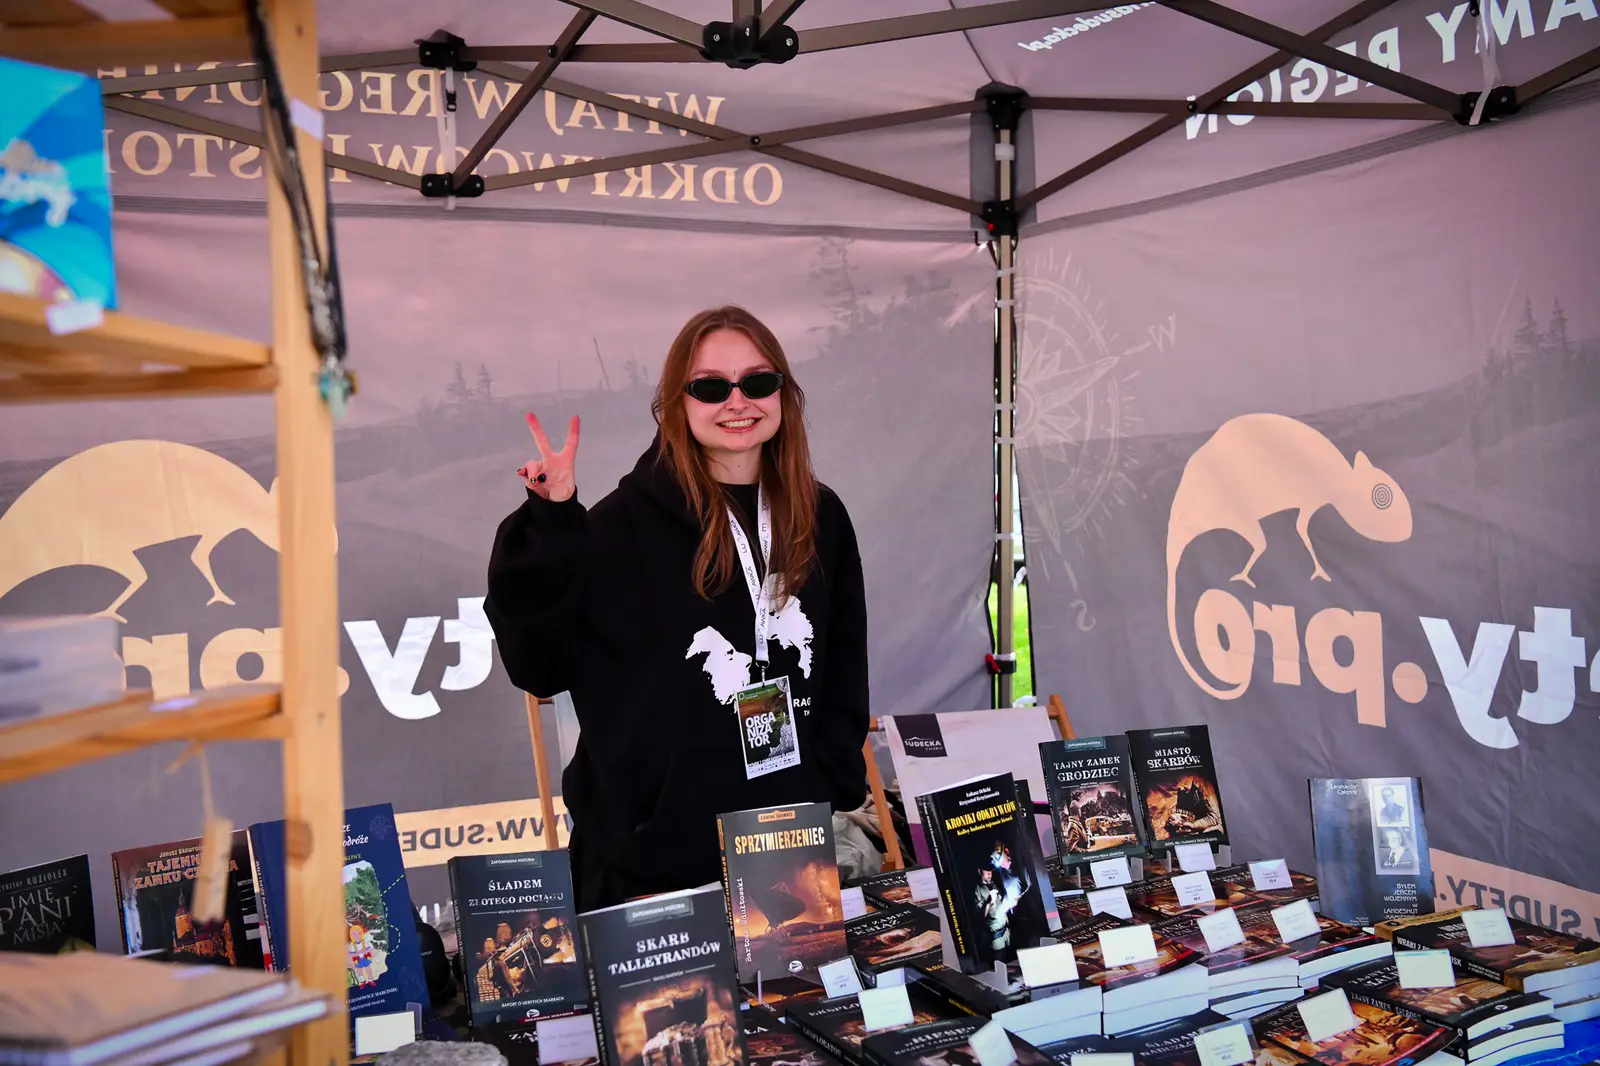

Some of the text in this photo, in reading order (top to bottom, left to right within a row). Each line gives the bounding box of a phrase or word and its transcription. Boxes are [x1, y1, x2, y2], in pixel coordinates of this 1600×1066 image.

[745, 711, 777, 728] ORGA
[747, 723, 774, 739] NIZA
[748, 734, 771, 749] TOR
[1155, 747, 1191, 757] MIASTO
[1053, 756, 1121, 771] TAJNY ZAMEK
[1147, 754, 1201, 769] SKARBÓW
[1057, 767, 1120, 782] GRODZIEC
[1330, 783, 1357, 791] Leonardo
[945, 800, 1017, 831] KRONIKI ODKRYWCÓW
[343, 834, 369, 848] odróże
[735, 826, 825, 855] SPRZYMIERZENIEC
[147, 855, 201, 874] TAJEMN
[134, 869, 181, 890] ZAMKU
[488, 878, 543, 892] ŚLADEM
[872, 909, 912, 926] ZAMEK
[636, 931, 690, 953] SKARB
[1397, 936, 1418, 949] WRAKI
[607, 941, 721, 976] TALLEYRANDÓW
